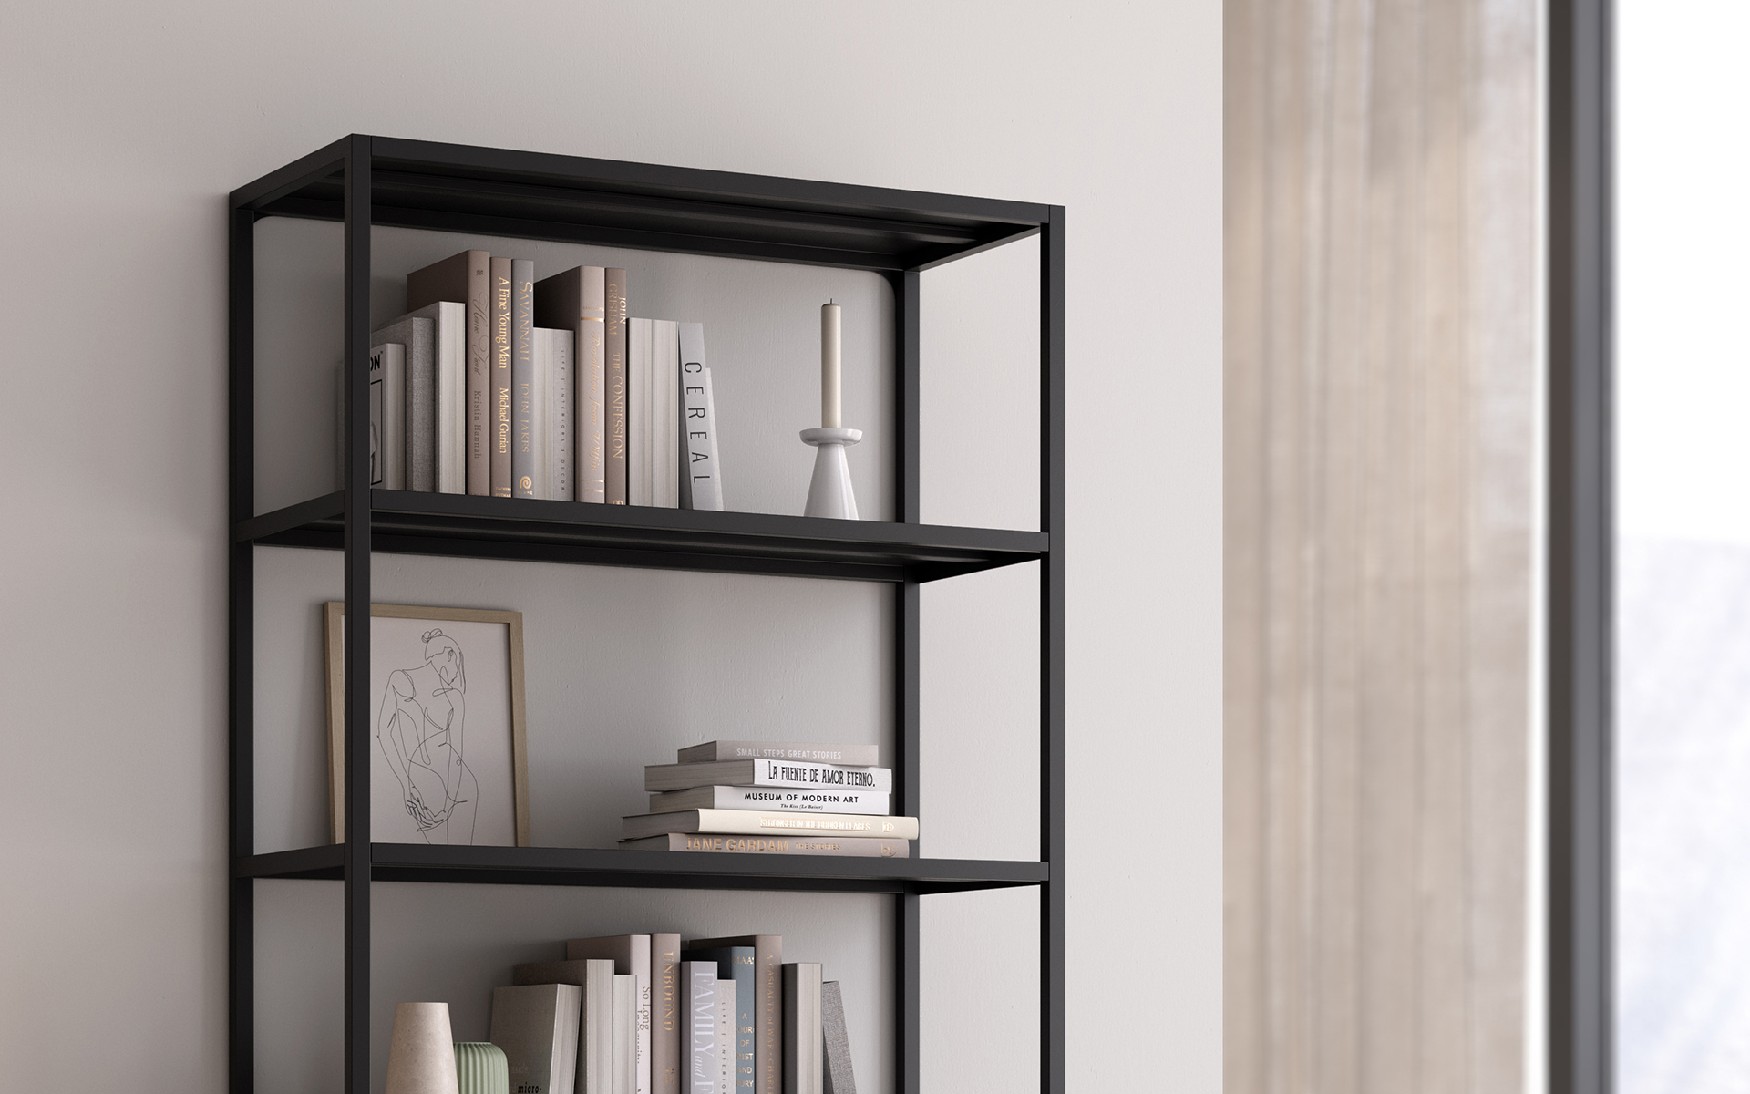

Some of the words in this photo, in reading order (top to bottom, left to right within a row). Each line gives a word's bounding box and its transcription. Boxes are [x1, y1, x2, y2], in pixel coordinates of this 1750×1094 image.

[499, 277, 510, 286] A
[499, 288, 510, 311] Fine
[607, 283, 618, 336] GRISHAM
[618, 297, 627, 325] JOHN
[495, 312, 510, 345] Young
[520, 281, 533, 361] SAVANNAH
[499, 346, 510, 369] Man
[612, 352, 621, 372] THE
[474, 390, 482, 421] Kristin
[499, 387, 510, 421] Michael
[520, 383, 530, 414] JOHN
[612, 375, 625, 460] CONFESSION
[684, 362, 711, 484] CEREAL
[474, 424, 482, 460] Hannah
[499, 423, 510, 454] Gurian
[520, 420, 530, 453] JAKES
[736, 748, 761, 758] SMALL
[763, 748, 785, 758] STEPS
[787, 749, 810, 759] GREAT
[812, 750, 842, 761] STORIES
[781, 766, 807, 782] FUENTE
[809, 768, 819, 783] DE
[821, 768, 844, 785] AMOR
[847, 770, 876, 788] ETERNO.
[744, 792, 783, 802] MUSEUM
[786, 793, 799, 802] OF
[801, 794, 840, 803] MODERN
[843, 795, 859, 804] ART
[686, 837, 722, 851] JANE
[725, 838, 789, 852] GARDAM
[642, 986, 651, 999] So
[663, 951, 675, 1031] UNBOUND
[767, 964, 775, 1013] CASUALTY
[639, 1003, 651, 1030] Long
[694, 972, 715, 1057] FAMILY
[740, 1040, 750, 1048] OF
[694, 1055, 706, 1079] and
